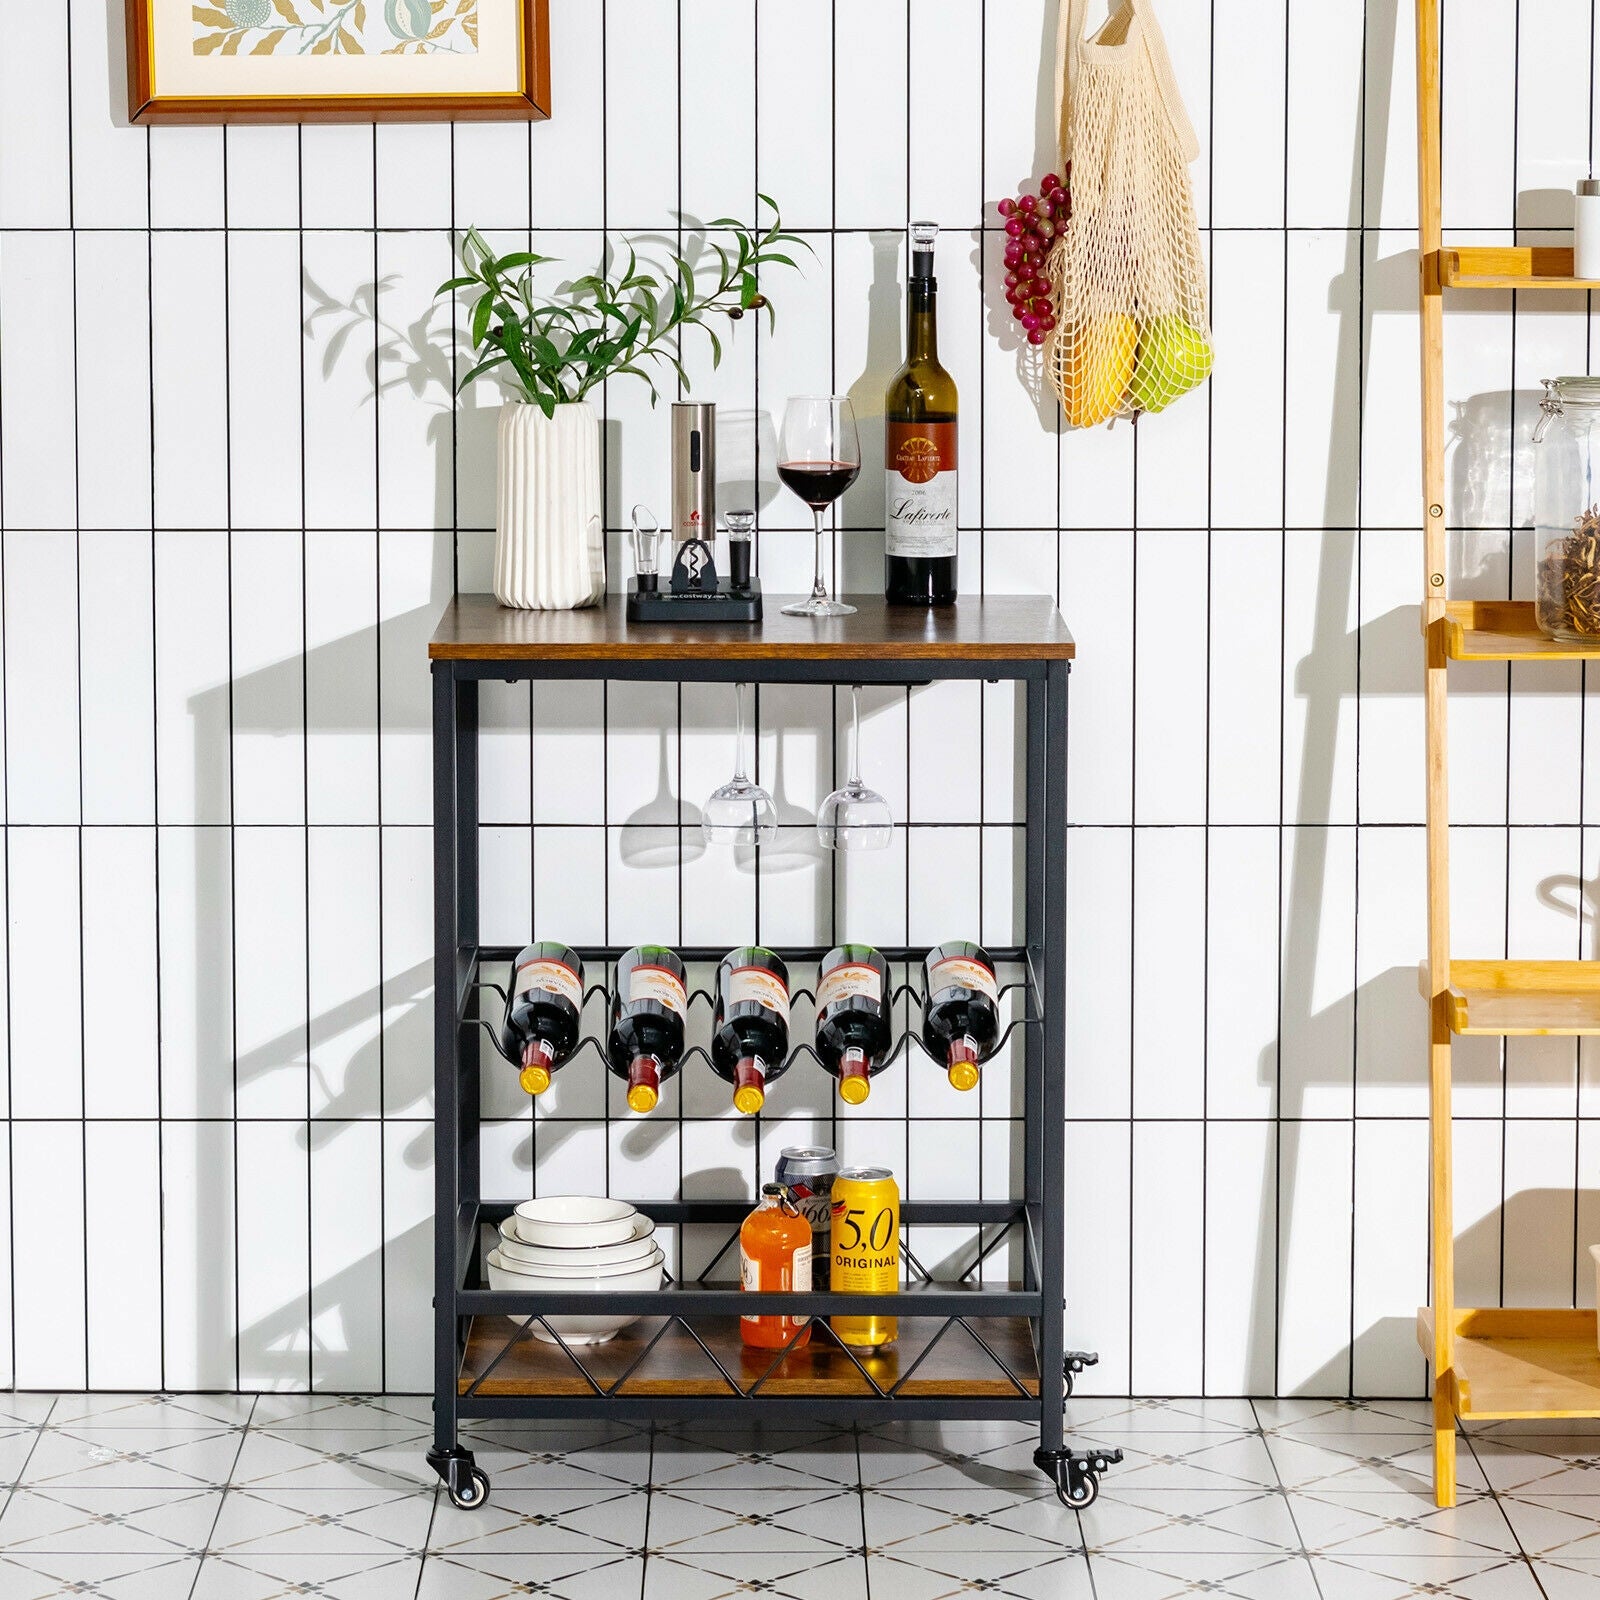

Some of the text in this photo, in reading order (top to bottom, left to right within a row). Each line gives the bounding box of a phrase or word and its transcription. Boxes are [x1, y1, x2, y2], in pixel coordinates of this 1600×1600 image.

[802, 1204, 831, 1224] 166
[839, 1207, 894, 1253] 5,0
[835, 1255, 896, 1269] ORIGINAL
